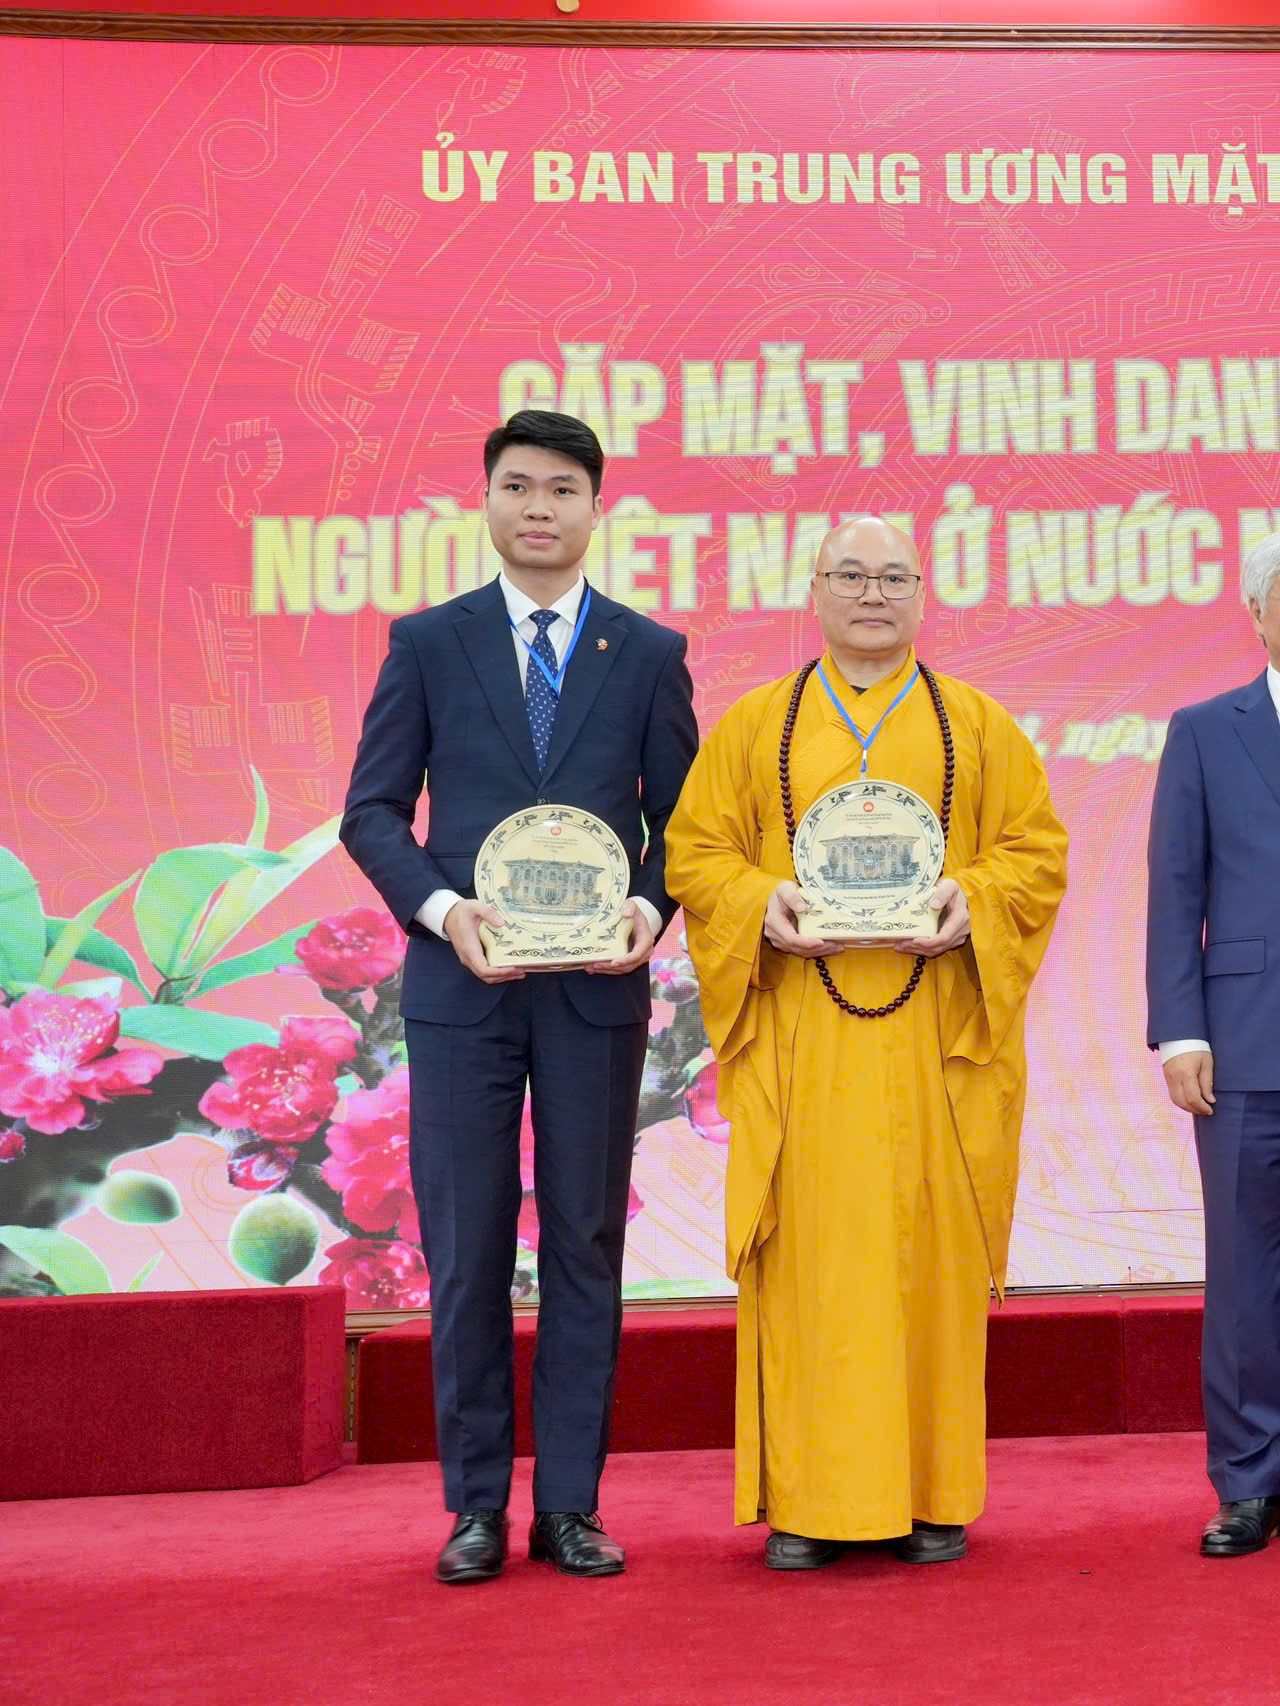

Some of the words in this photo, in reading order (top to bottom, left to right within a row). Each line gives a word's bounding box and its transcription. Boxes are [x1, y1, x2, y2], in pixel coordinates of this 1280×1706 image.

[422, 131, 509, 203] ỦY
[533, 150, 674, 204] BAN
[696, 151, 921, 205] TRUNG
[944, 147, 1128, 206] ƯƠNG
[682, 342, 885, 475] MẶT,
[899, 359, 1097, 456] VINH
[250, 497, 503, 616] NGƯỜ
[726, 512, 915, 612] NA
[932, 483, 993, 609] Ở
[1006, 491, 1223, 608] NƯỚC
